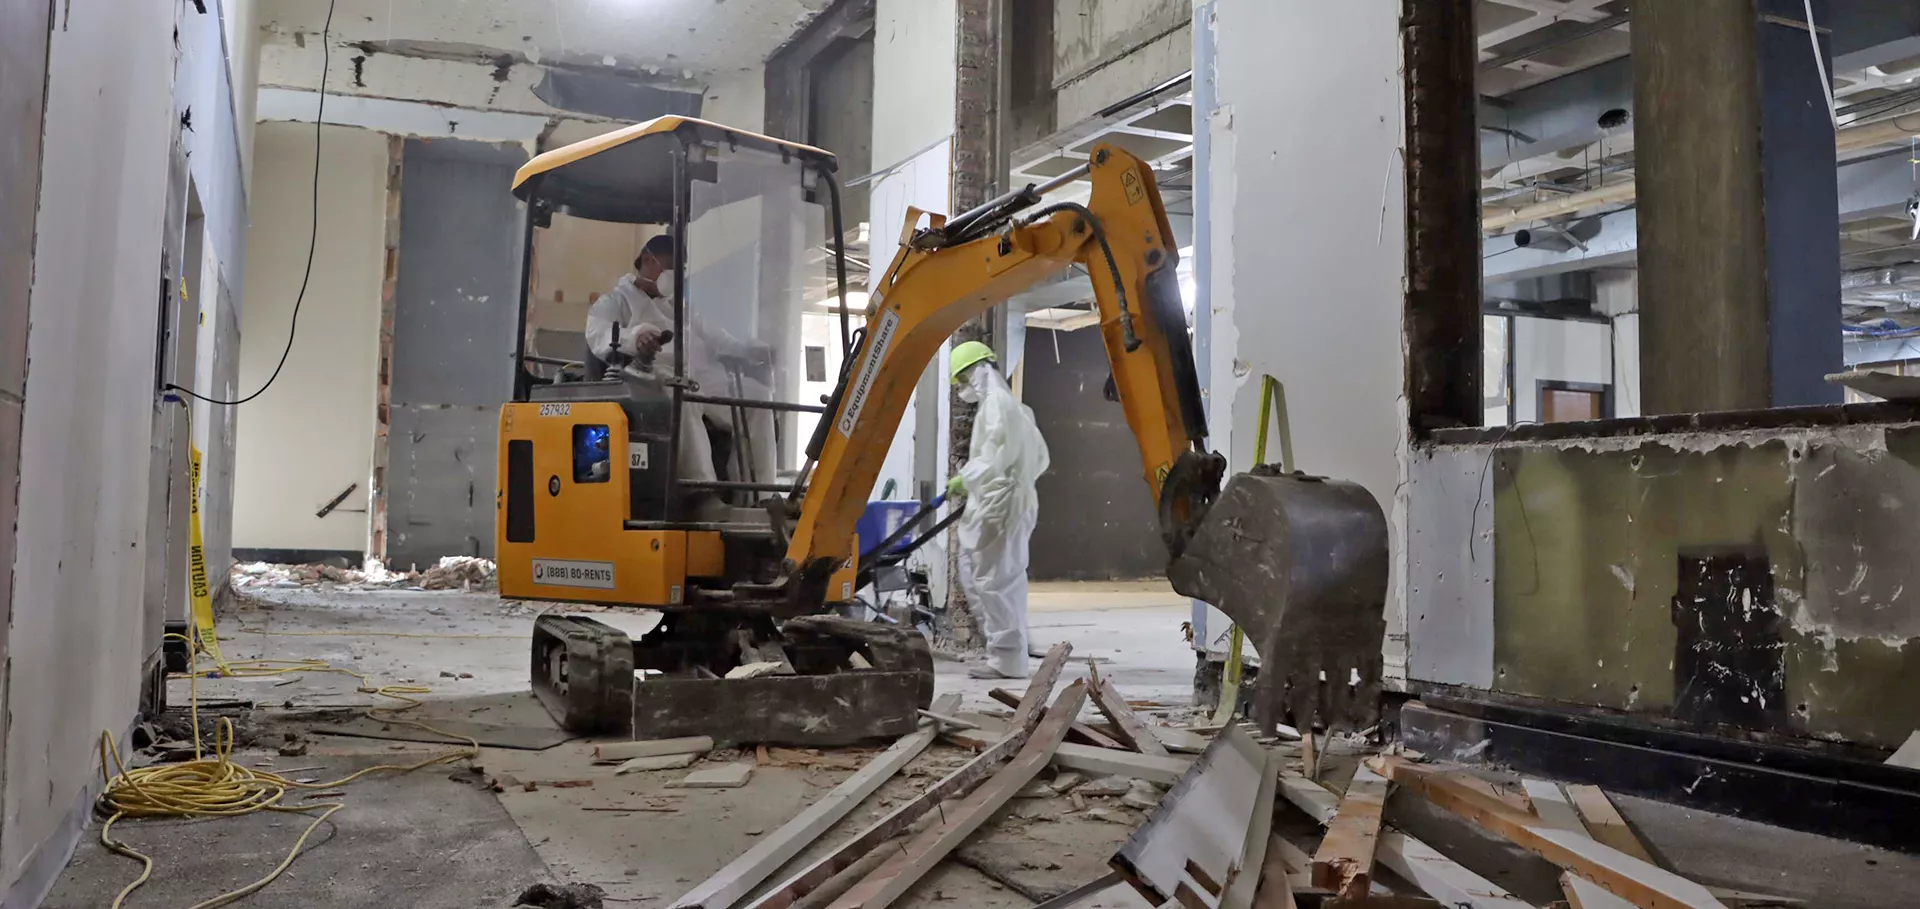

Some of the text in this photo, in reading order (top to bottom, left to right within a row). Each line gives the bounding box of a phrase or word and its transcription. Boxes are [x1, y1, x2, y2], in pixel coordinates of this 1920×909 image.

[847, 318, 893, 419] EquipmentShare
[539, 403, 570, 416] 257932
[546, 566, 611, 581] (888) 80-RENTS
